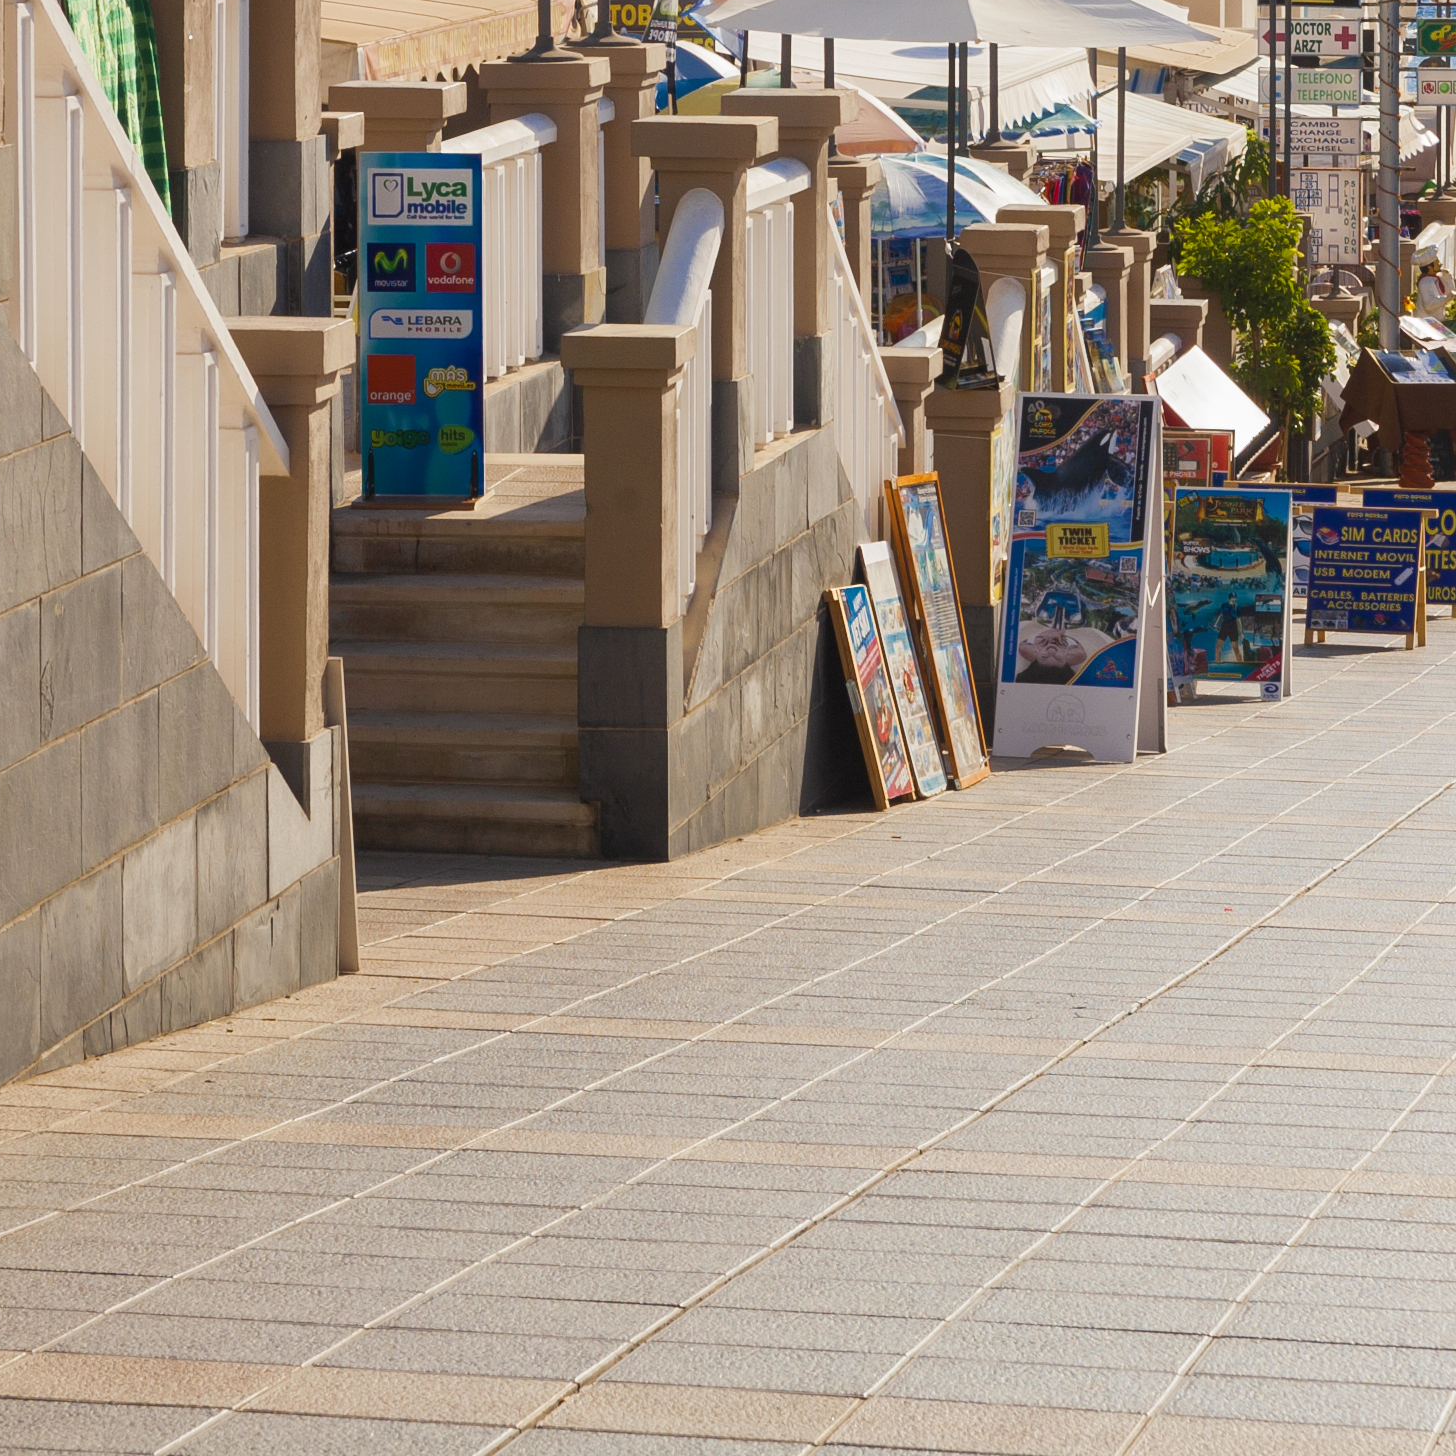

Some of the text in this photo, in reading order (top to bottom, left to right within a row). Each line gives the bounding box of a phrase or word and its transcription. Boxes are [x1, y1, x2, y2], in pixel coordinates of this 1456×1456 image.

[1290, 22, 1332, 36] DOCTOR
[1294, 39, 1323, 53] ARZT
[1297, 72, 1353, 85] TELEFONO
[1297, 89, 1358, 101] TELEPHONE
[406, 176, 468, 203] Lyca
[406, 199, 468, 215] mobile
[374, 279, 409, 287] movistar
[427, 275, 474, 285] vodafone
[407, 316, 462, 326] LEBARA
[370, 390, 412, 403] orange
[371, 429, 430, 449] yoigo
[440, 429, 466, 442] hits
[1061, 527, 1093, 537] TWIN
[1341, 526, 1418, 544] SIM CARDS
[1058, 536, 1098, 546] TICKET
[1183, 545, 1211, 554] SHOWS
[1314, 549, 1416, 563] INTERNET MOVIL
[1313, 567, 1391, 580] USB MODEM
[1361, 591, 1415, 603] BATTERIES
